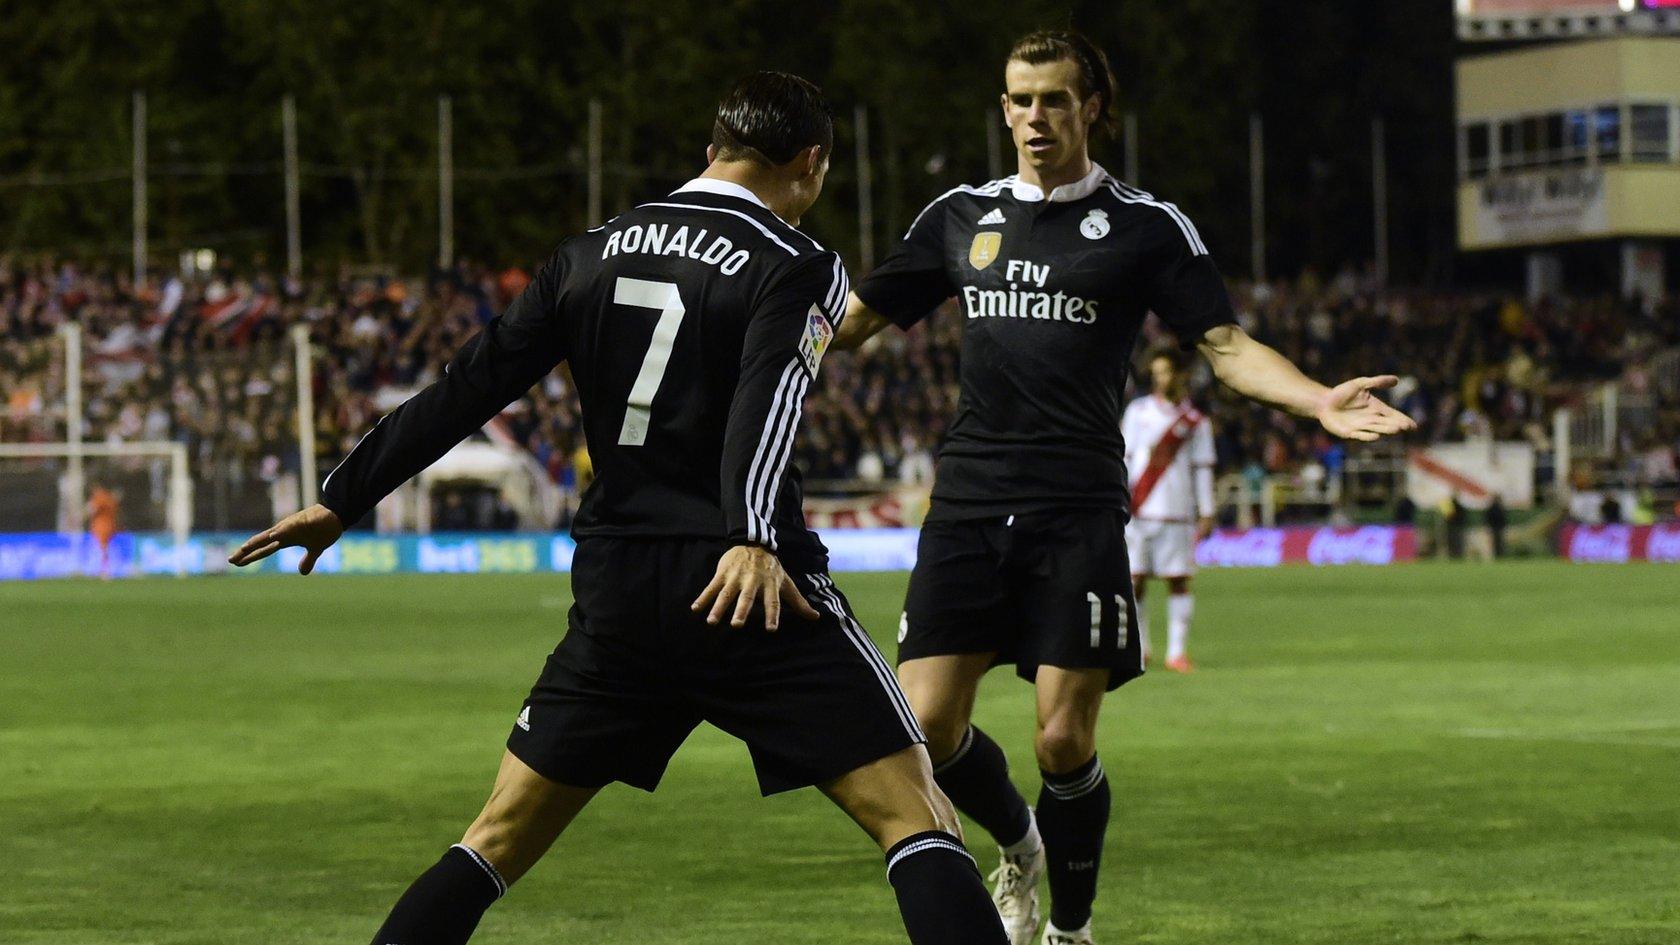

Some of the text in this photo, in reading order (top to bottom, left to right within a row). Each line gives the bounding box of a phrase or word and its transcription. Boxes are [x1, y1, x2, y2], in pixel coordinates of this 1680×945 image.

[602, 223, 750, 276] RONALDO
[1005, 259, 1050, 288] Fly
[962, 282, 1099, 324] Emirates
[613, 277, 686, 446] 7
[1087, 591, 1128, 649] 11
